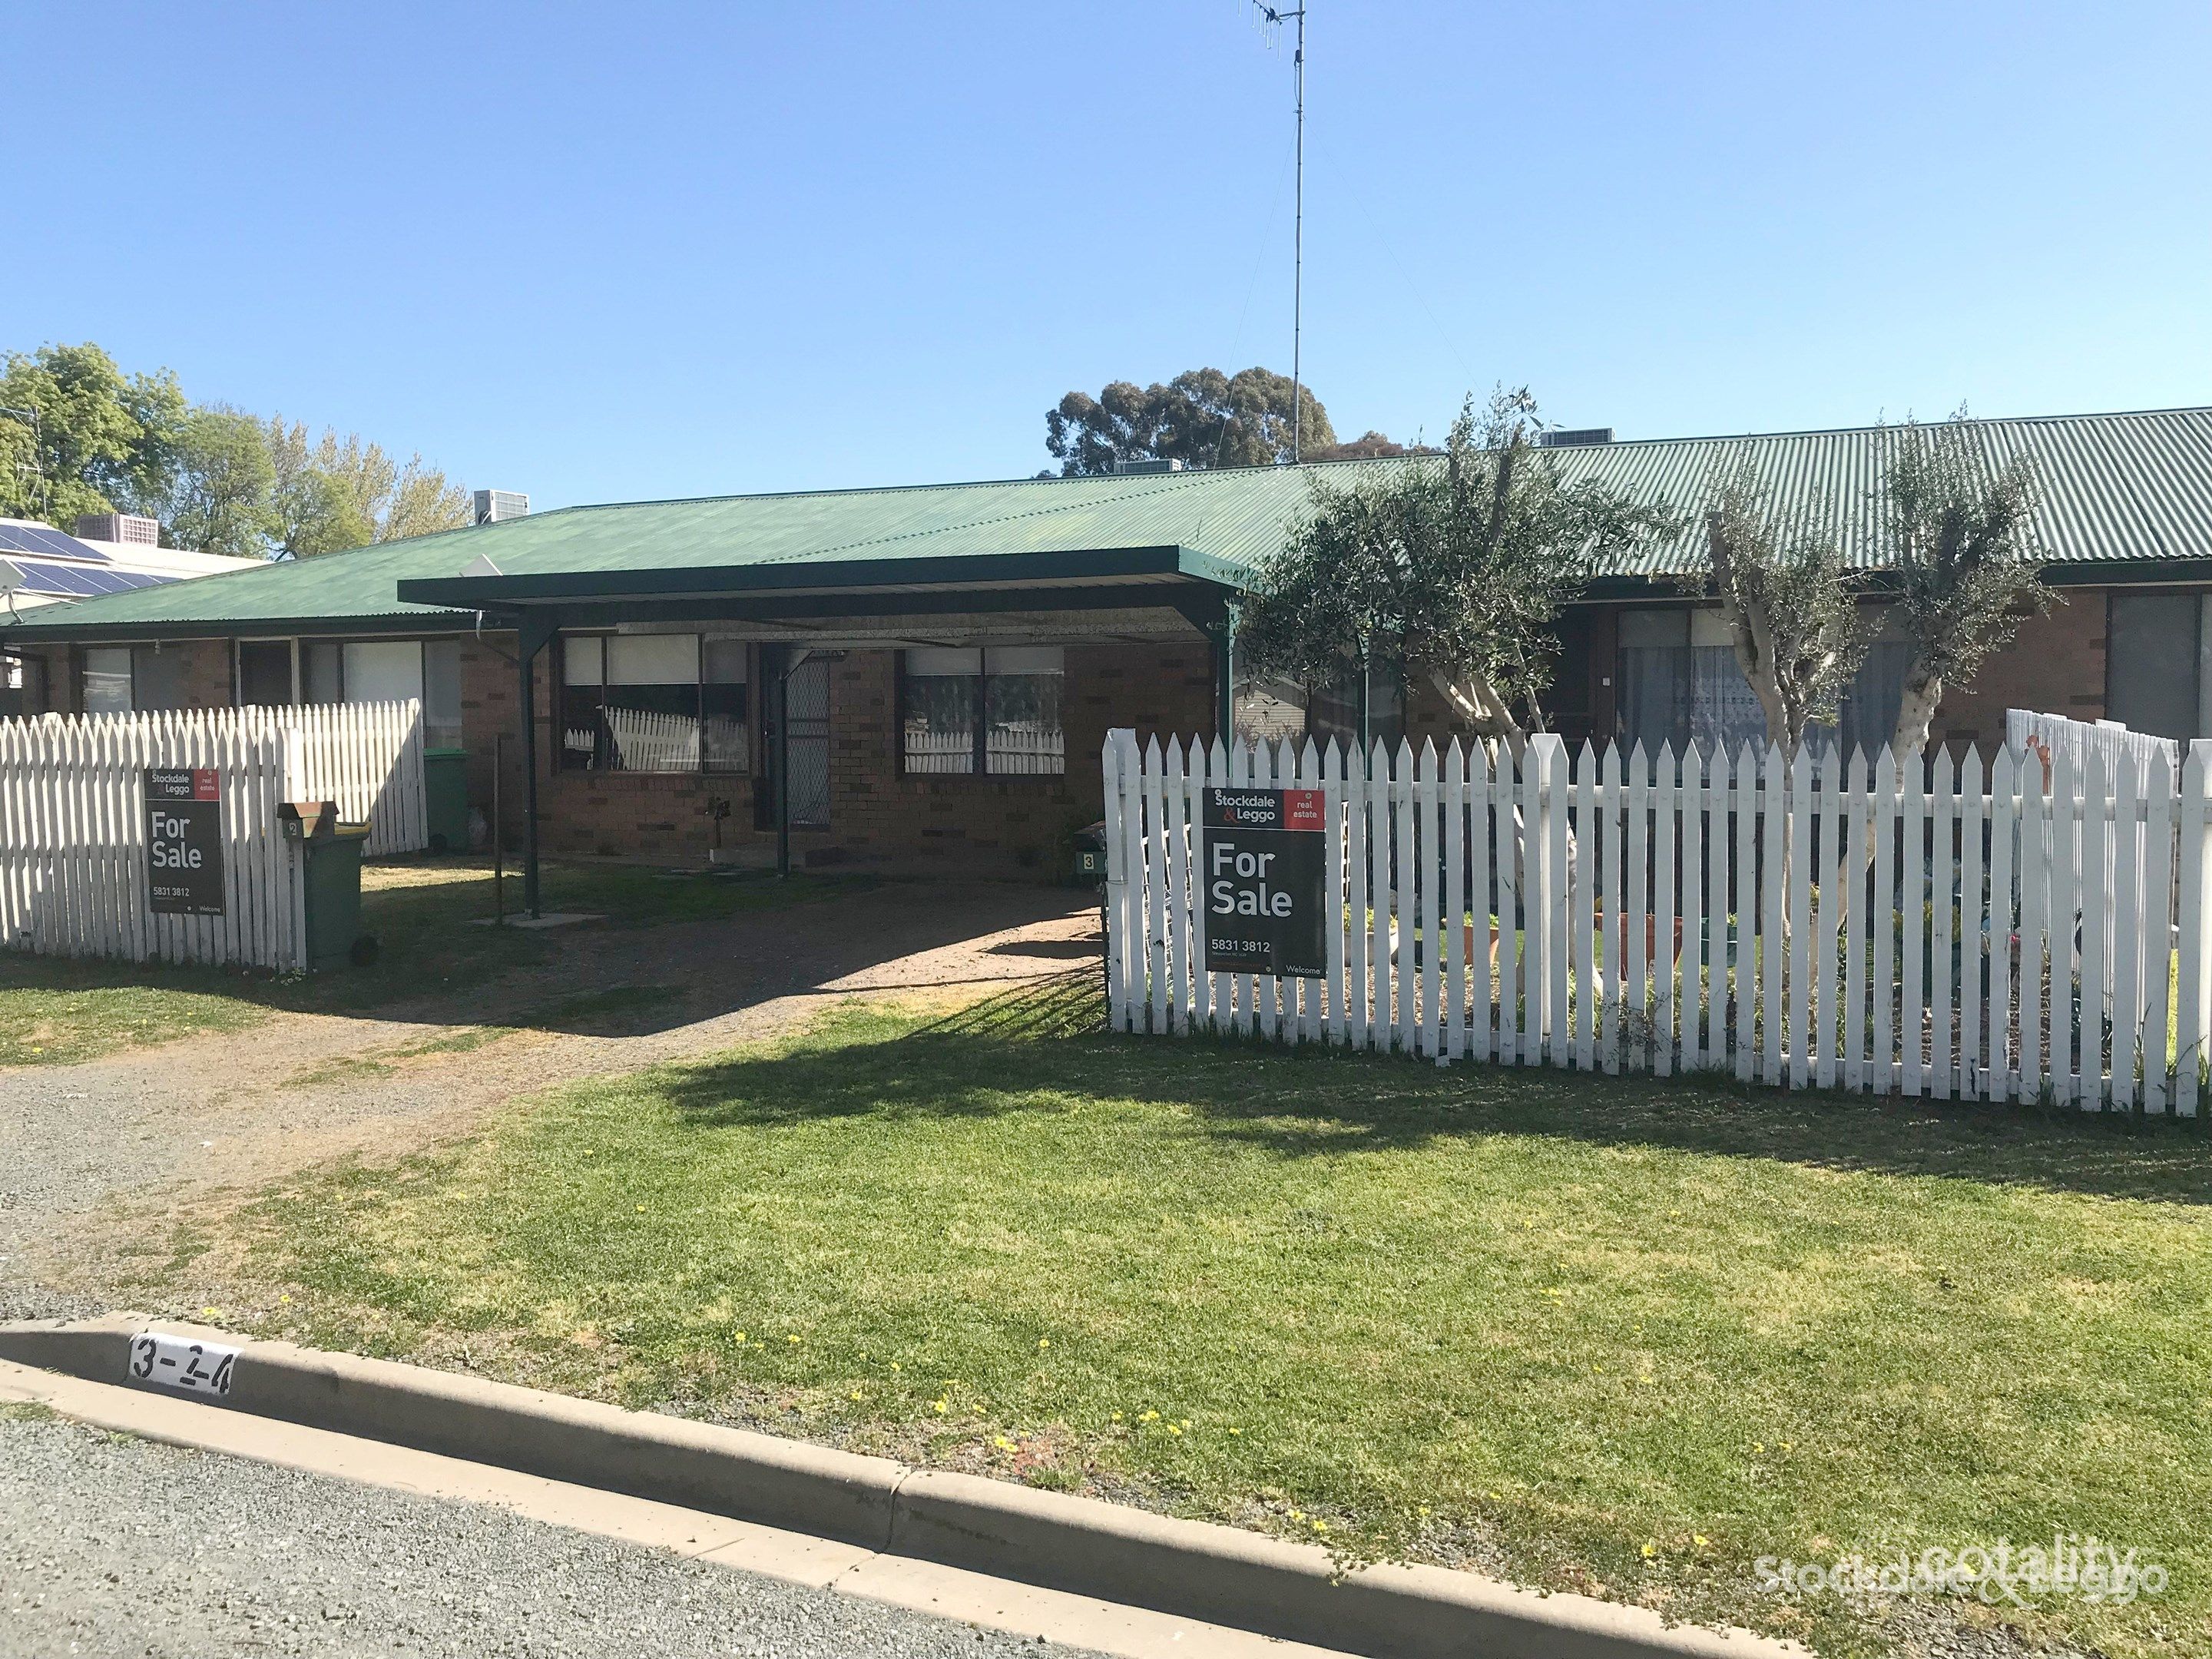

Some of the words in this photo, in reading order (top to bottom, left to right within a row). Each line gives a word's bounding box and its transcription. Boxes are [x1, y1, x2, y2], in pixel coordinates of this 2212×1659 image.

[152, 773, 190, 783] Stockdale
[165, 783, 190, 796] Leggo
[1214, 792, 1275, 807] Stockdale
[1296, 800, 1313, 809] real
[1224, 806, 1240, 823] &
[1237, 807, 1275, 823] Leggo
[1293, 810, 1317, 819] estate
[151, 811, 190, 839] For
[151, 841, 202, 869] Sale
[1084, 855, 1094, 868] 3
[1213, 843, 1276, 879] For
[154, 886, 170, 896] 5831
[172, 888, 190, 897] 3812
[1211, 880, 1293, 917] Sale
[1211, 939, 1238, 951] 5831
[1242, 940, 1270, 952] 3812
[1286, 965, 1321, 975] Welcome
